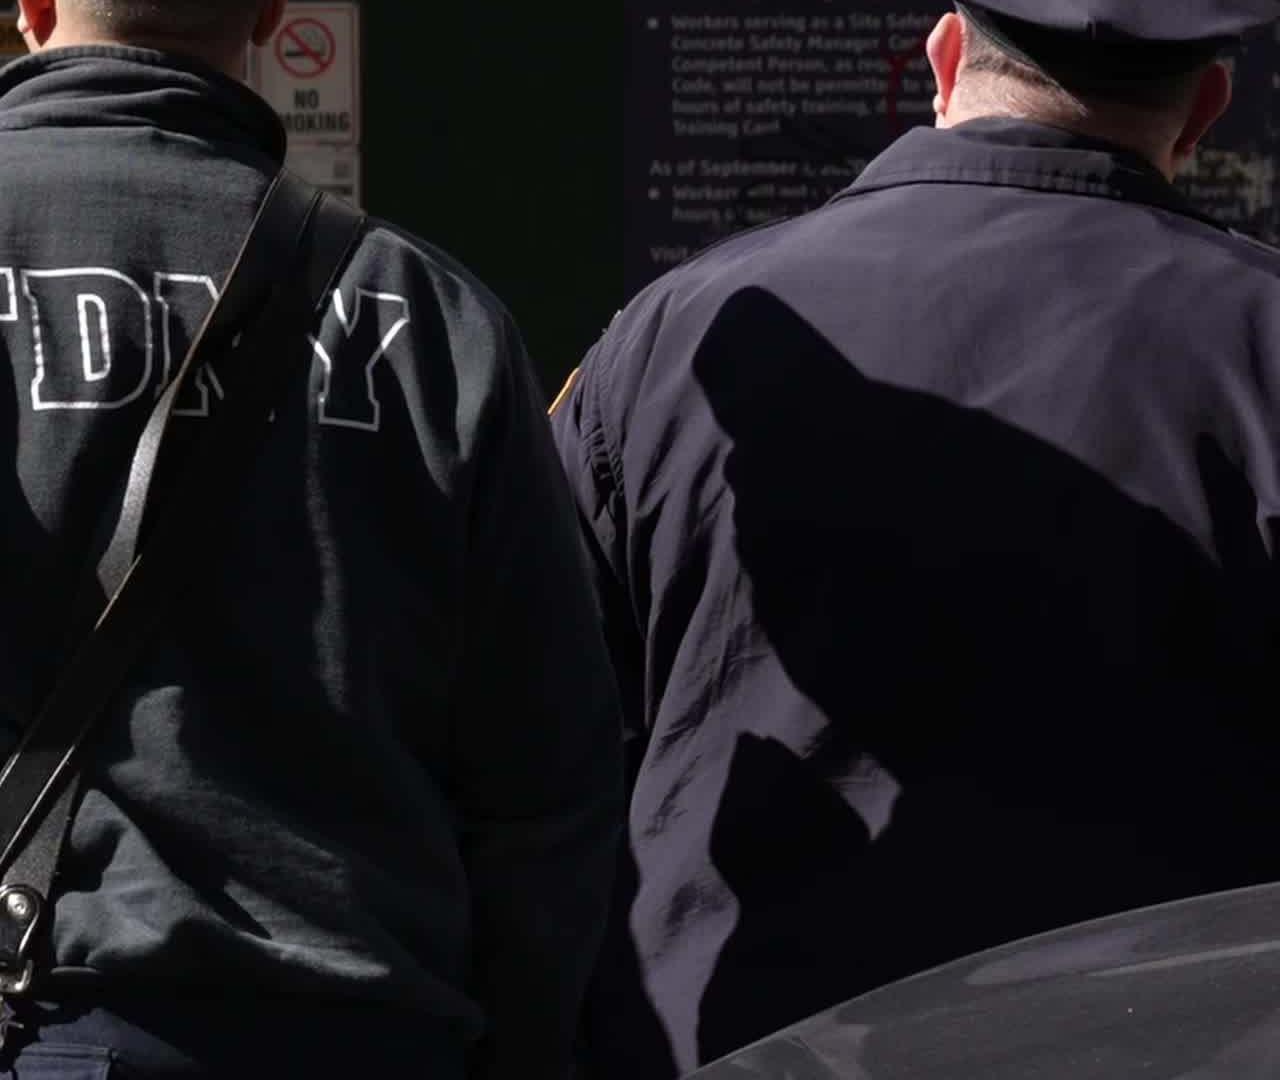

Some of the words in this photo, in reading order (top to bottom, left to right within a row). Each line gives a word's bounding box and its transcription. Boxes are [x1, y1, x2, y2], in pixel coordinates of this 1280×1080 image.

[671, 13, 739, 29] Workers
[743, 13, 807, 33] serving
[848, 12, 881, 29] Site
[671, 34, 743, 53] Concrete
[746, 34, 801, 54] Safety
[671, 56, 762, 76] Competent
[721, 77, 752, 93] will
[756, 78, 785, 93] not
[789, 77, 811, 93] be
[293, 89, 320, 110] NO
[672, 97, 720, 114] hours
[723, 96, 741, 114] of
[744, 97, 798, 117] safety
[276, 111, 351, 133] MOKING
[672, 119, 740, 139] Training
[649, 159, 673, 177] As
[676, 157, 697, 177] of
[699, 159, 799, 179] September
